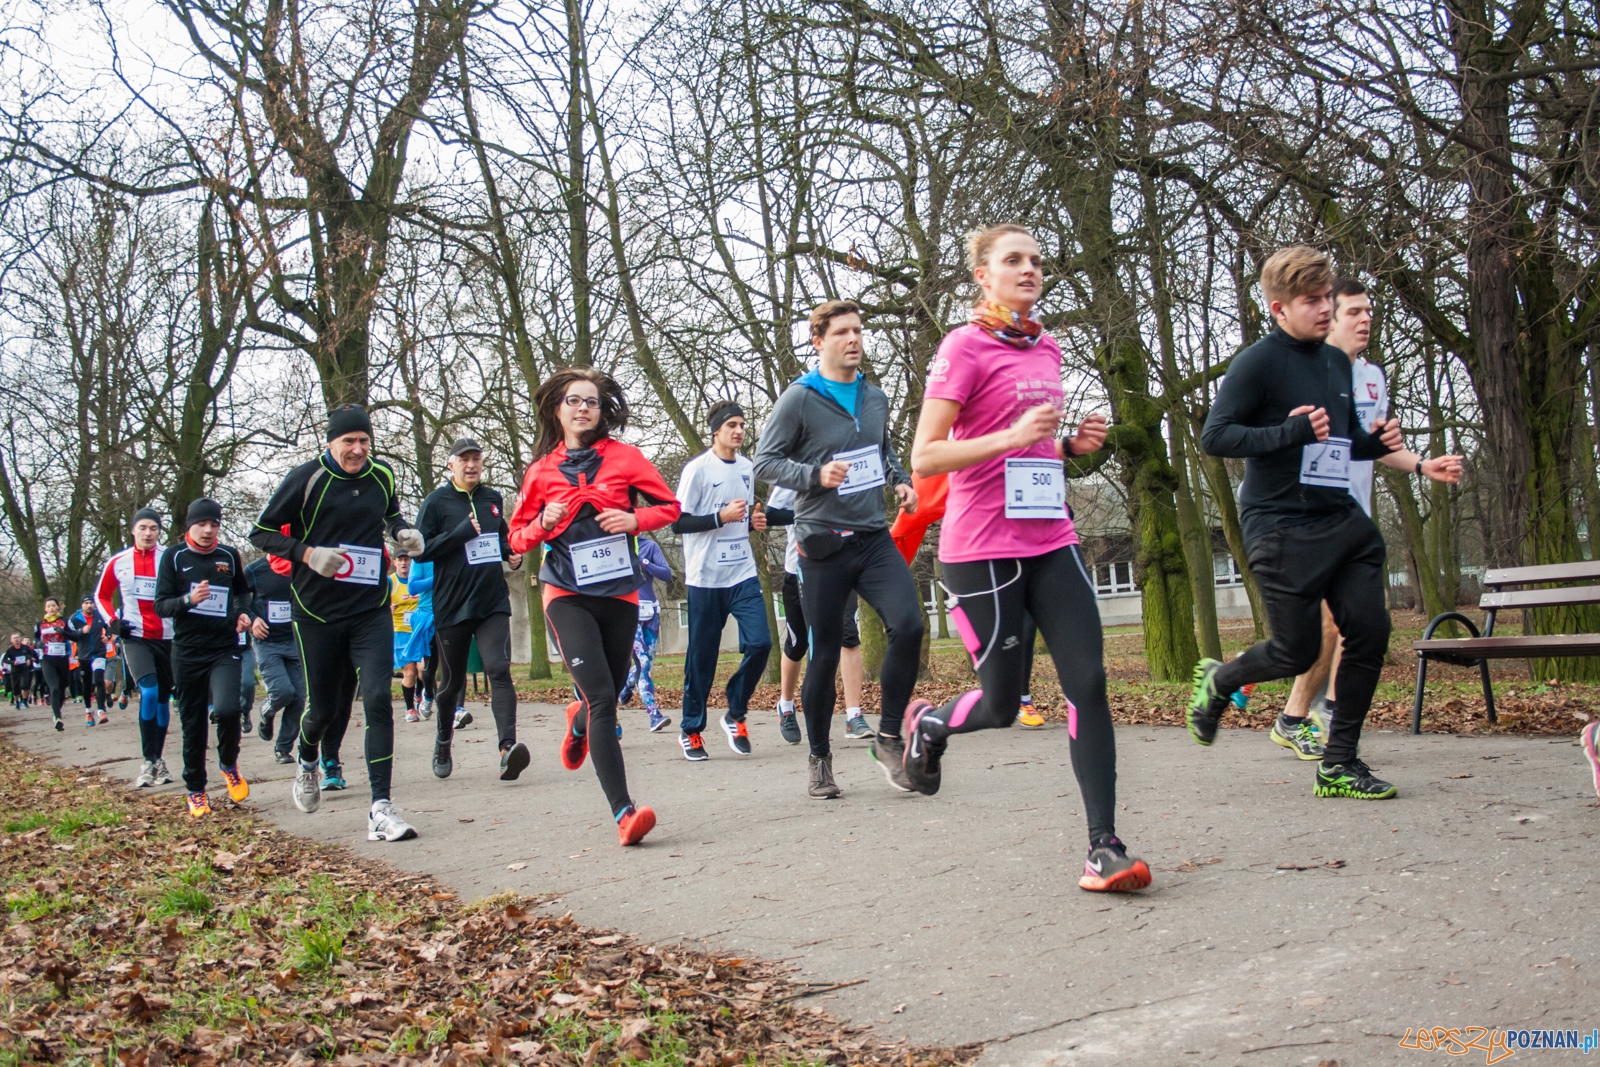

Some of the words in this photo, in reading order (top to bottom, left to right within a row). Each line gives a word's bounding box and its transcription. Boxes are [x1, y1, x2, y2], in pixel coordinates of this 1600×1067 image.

[1330, 450, 1341, 460] 42
[853, 460, 868, 471] 971
[1032, 473, 1051, 485] 500
[479, 540, 490, 548] 266
[592, 547, 611, 558] 436
[357, 556, 366, 565] 33
